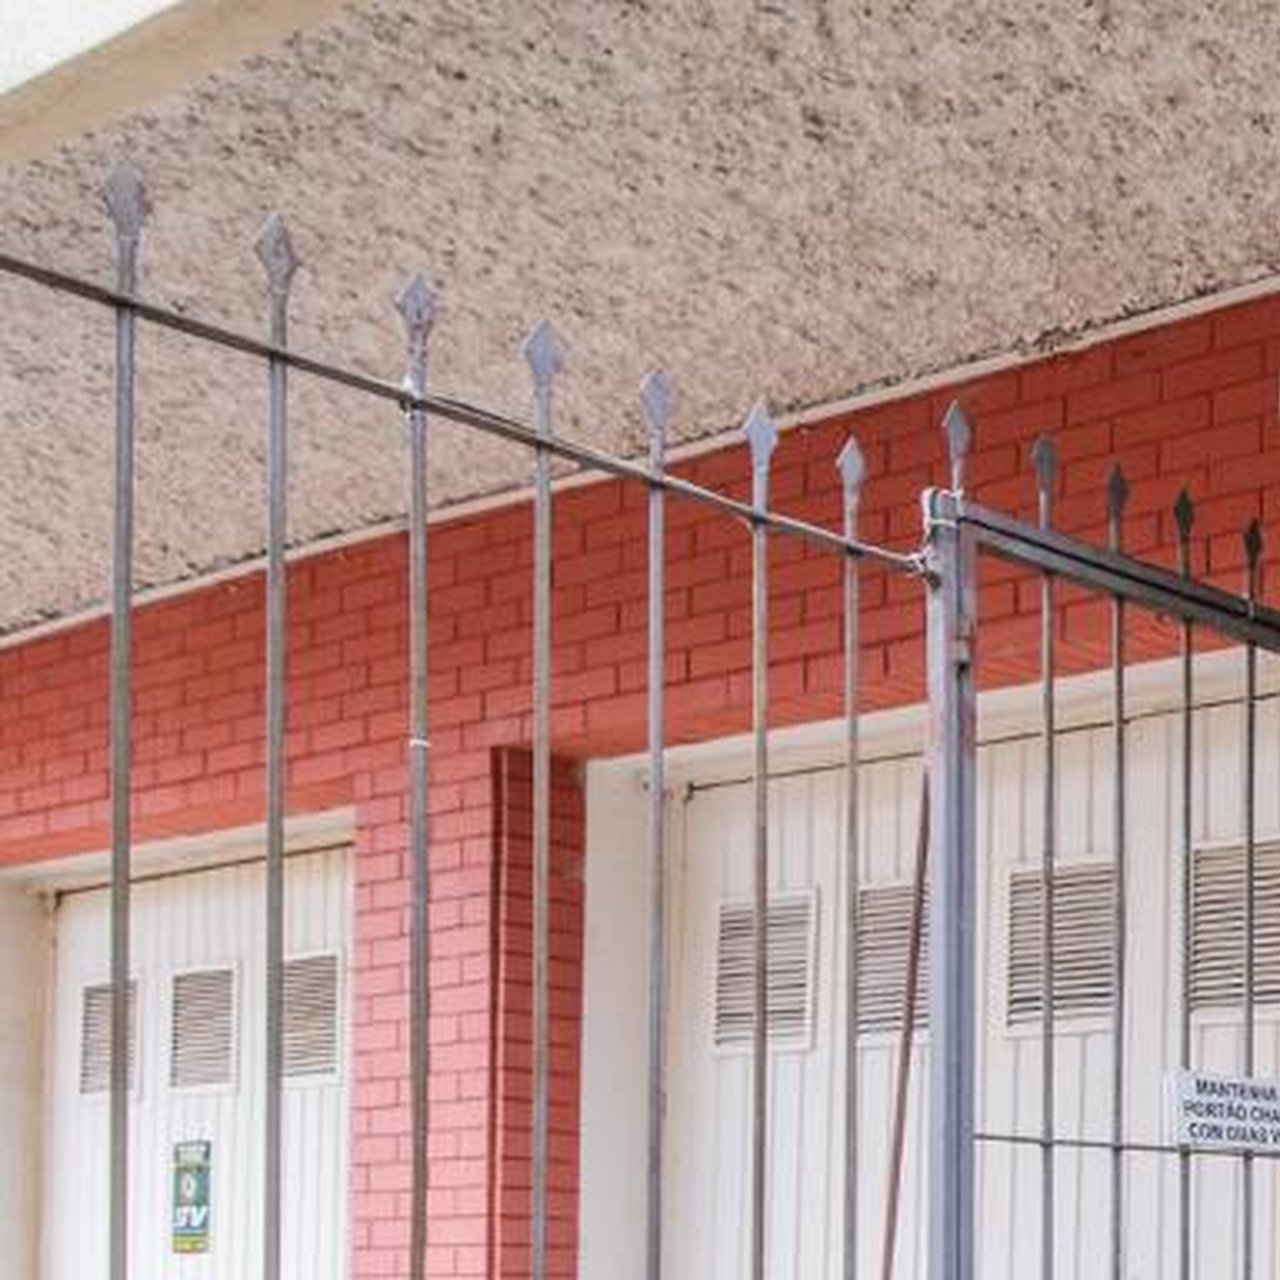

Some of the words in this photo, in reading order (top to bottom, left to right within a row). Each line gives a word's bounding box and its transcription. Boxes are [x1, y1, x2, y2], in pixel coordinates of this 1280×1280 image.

[1195, 1079, 1277, 1102] MANTENHA
[1183, 1101, 1247, 1121] PORTÃO
[1226, 1126, 1267, 1143] DUAS
